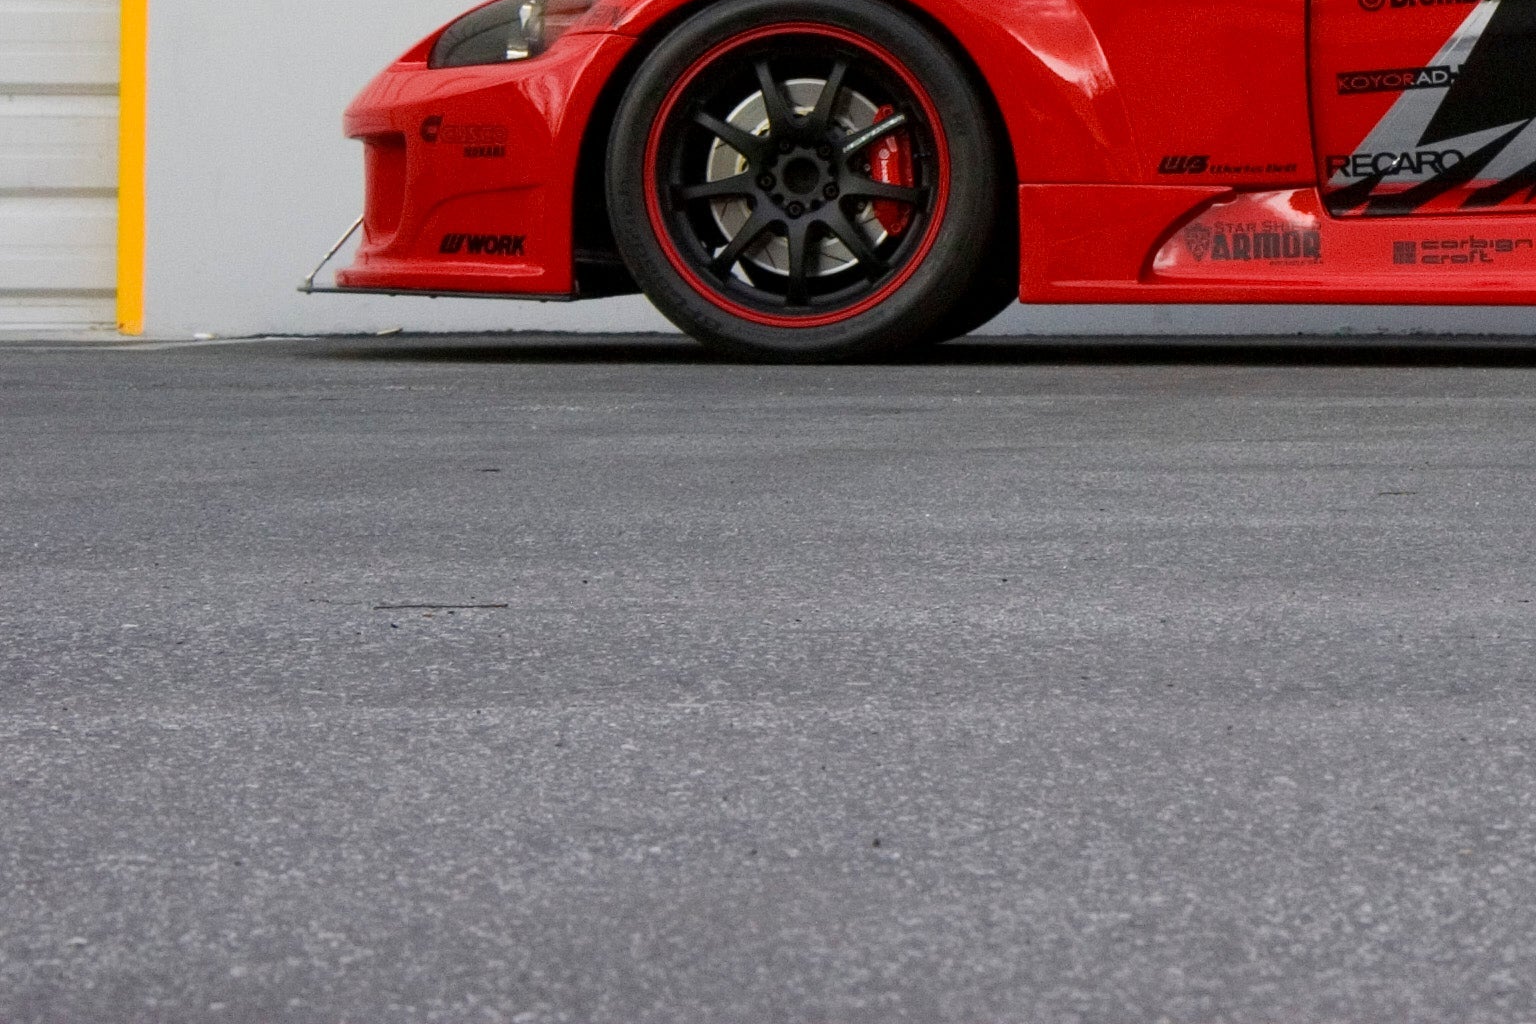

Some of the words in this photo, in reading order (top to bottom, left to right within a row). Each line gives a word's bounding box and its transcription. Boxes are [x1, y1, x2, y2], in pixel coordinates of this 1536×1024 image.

[1325, 148, 1466, 178] RECARO
[466, 233, 526, 256] WORK
[1211, 232, 1322, 260] ARMOR
